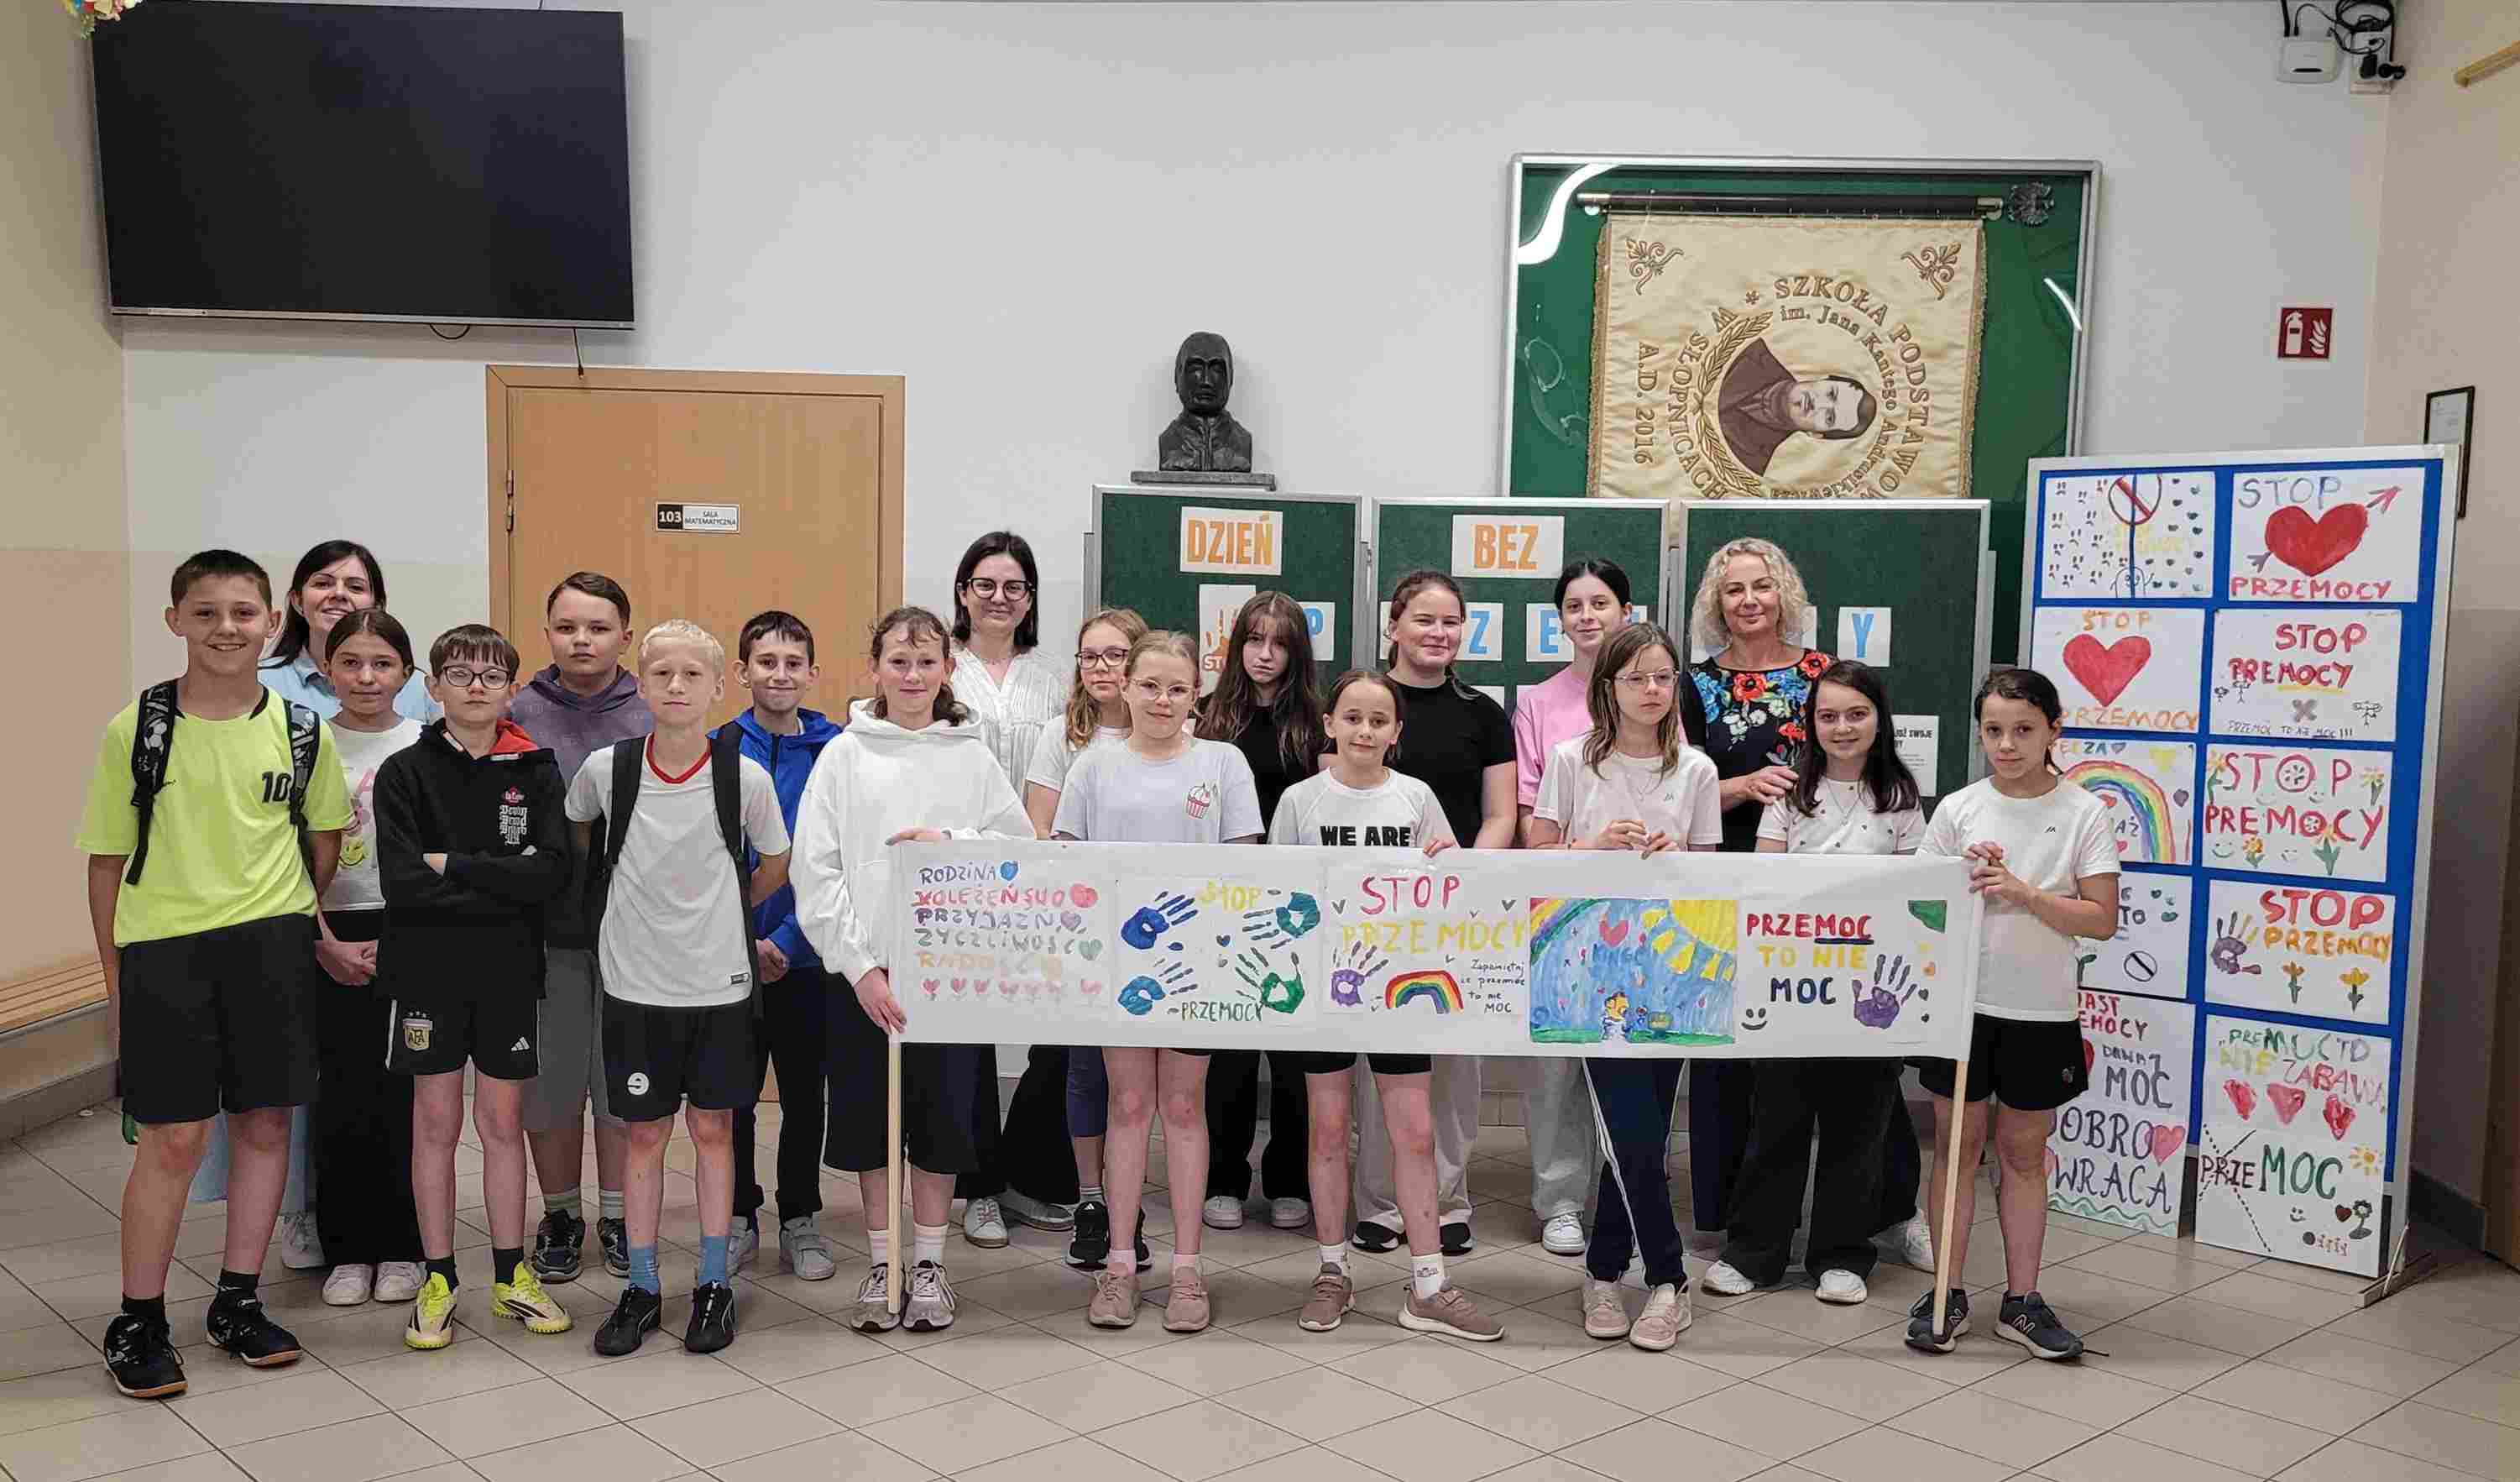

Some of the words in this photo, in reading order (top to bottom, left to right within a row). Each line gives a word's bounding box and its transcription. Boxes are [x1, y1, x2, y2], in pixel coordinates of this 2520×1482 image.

[1712, 306, 1738, 333] W
[1775, 275, 1889, 327] SZKOŁA
[1637, 341, 1660, 399] A.D.
[1780, 306, 1812, 322] im.
[1817, 305, 1859, 337] Jana
[1862, 333, 1897, 411] Kantego
[1633, 407, 1656, 465] 2016
[2237, 476, 2341, 510] STOP
[659, 511, 682, 523] 103
[1187, 511, 1273, 566] DZIEŃ
[1473, 523, 1540, 571] BEZ
[2230, 575, 2392, 601] PRZEMOCY
[1851, 612, 1874, 657] Y
[2082, 609, 2152, 631] STOP
[2275, 622, 2367, 654] STOP
[261, 771, 291, 804] 10
[2223, 751, 2351, 796] STOP
[1320, 825, 1357, 846] WE
[1364, 826, 1411, 847] ARE
[2204, 804, 2384, 851] PREMOCY
[1360, 874, 1460, 916] STOP
[2259, 889, 2386, 930] STOP
[1341, 918, 1525, 955] PRZEMOCY
[1746, 913, 1873, 940] PRZEMOC
[1759, 945, 1797, 968] TO
[1812, 945, 1868, 970] NIE
[1484, 1002, 1512, 1014] MOC
[1770, 977, 1837, 1005] MOC
[1181, 999, 1265, 1023] PRZEMOCY
[2104, 1065, 2173, 1108] MOC
[2049, 1105, 2153, 1161] OBRO
[2054, 1155, 2172, 1214] WRACA
